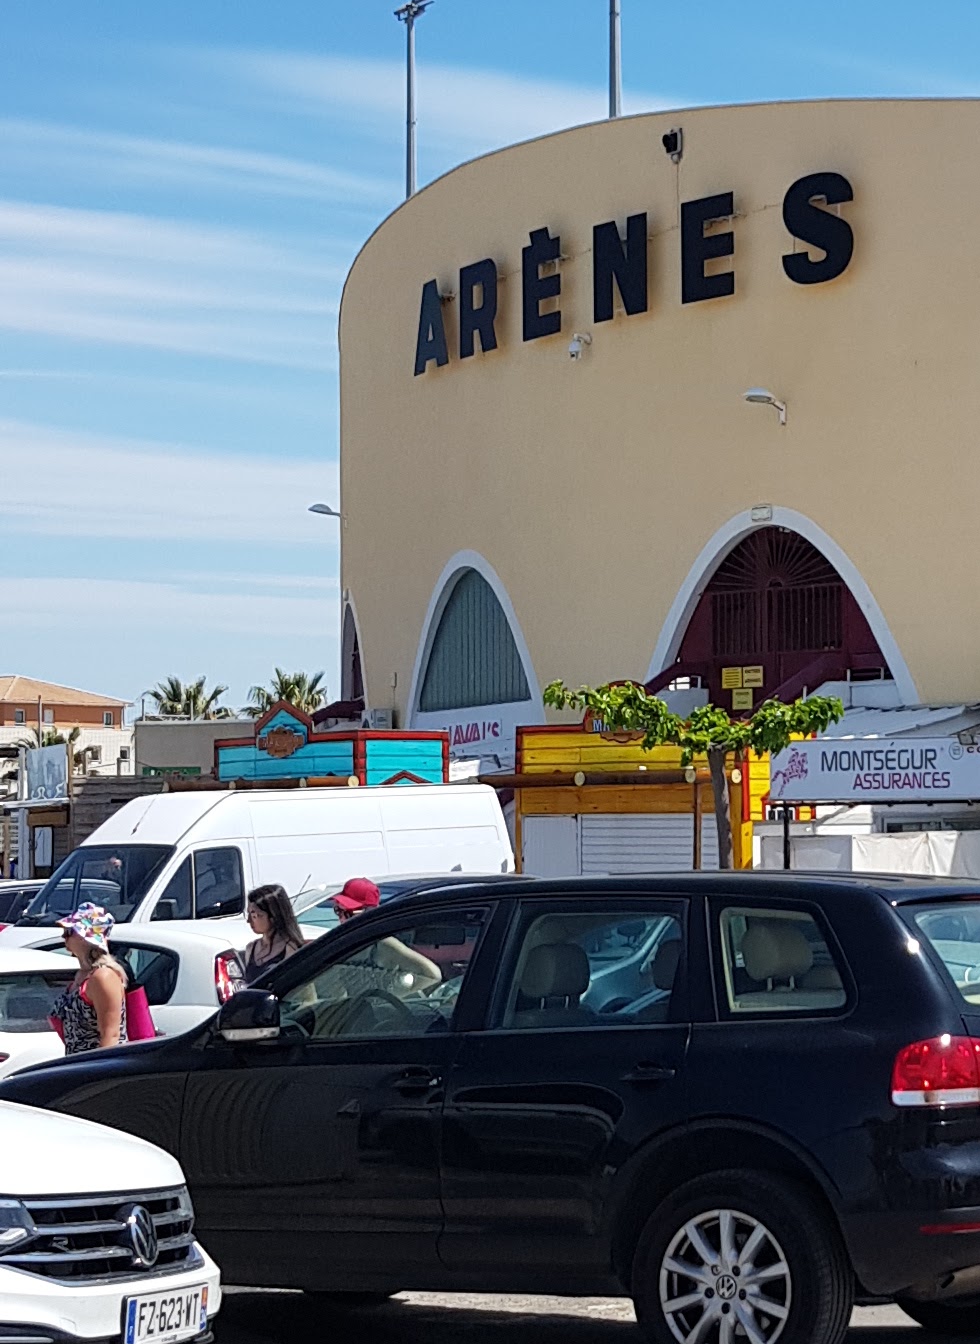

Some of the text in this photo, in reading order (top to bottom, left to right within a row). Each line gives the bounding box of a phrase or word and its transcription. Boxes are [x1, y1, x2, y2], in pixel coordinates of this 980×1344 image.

[414, 171, 855, 376] ARÈNES
[821, 742, 938, 771] MONTSÉGUR
[853, 772, 951, 790] ASSURANCES
